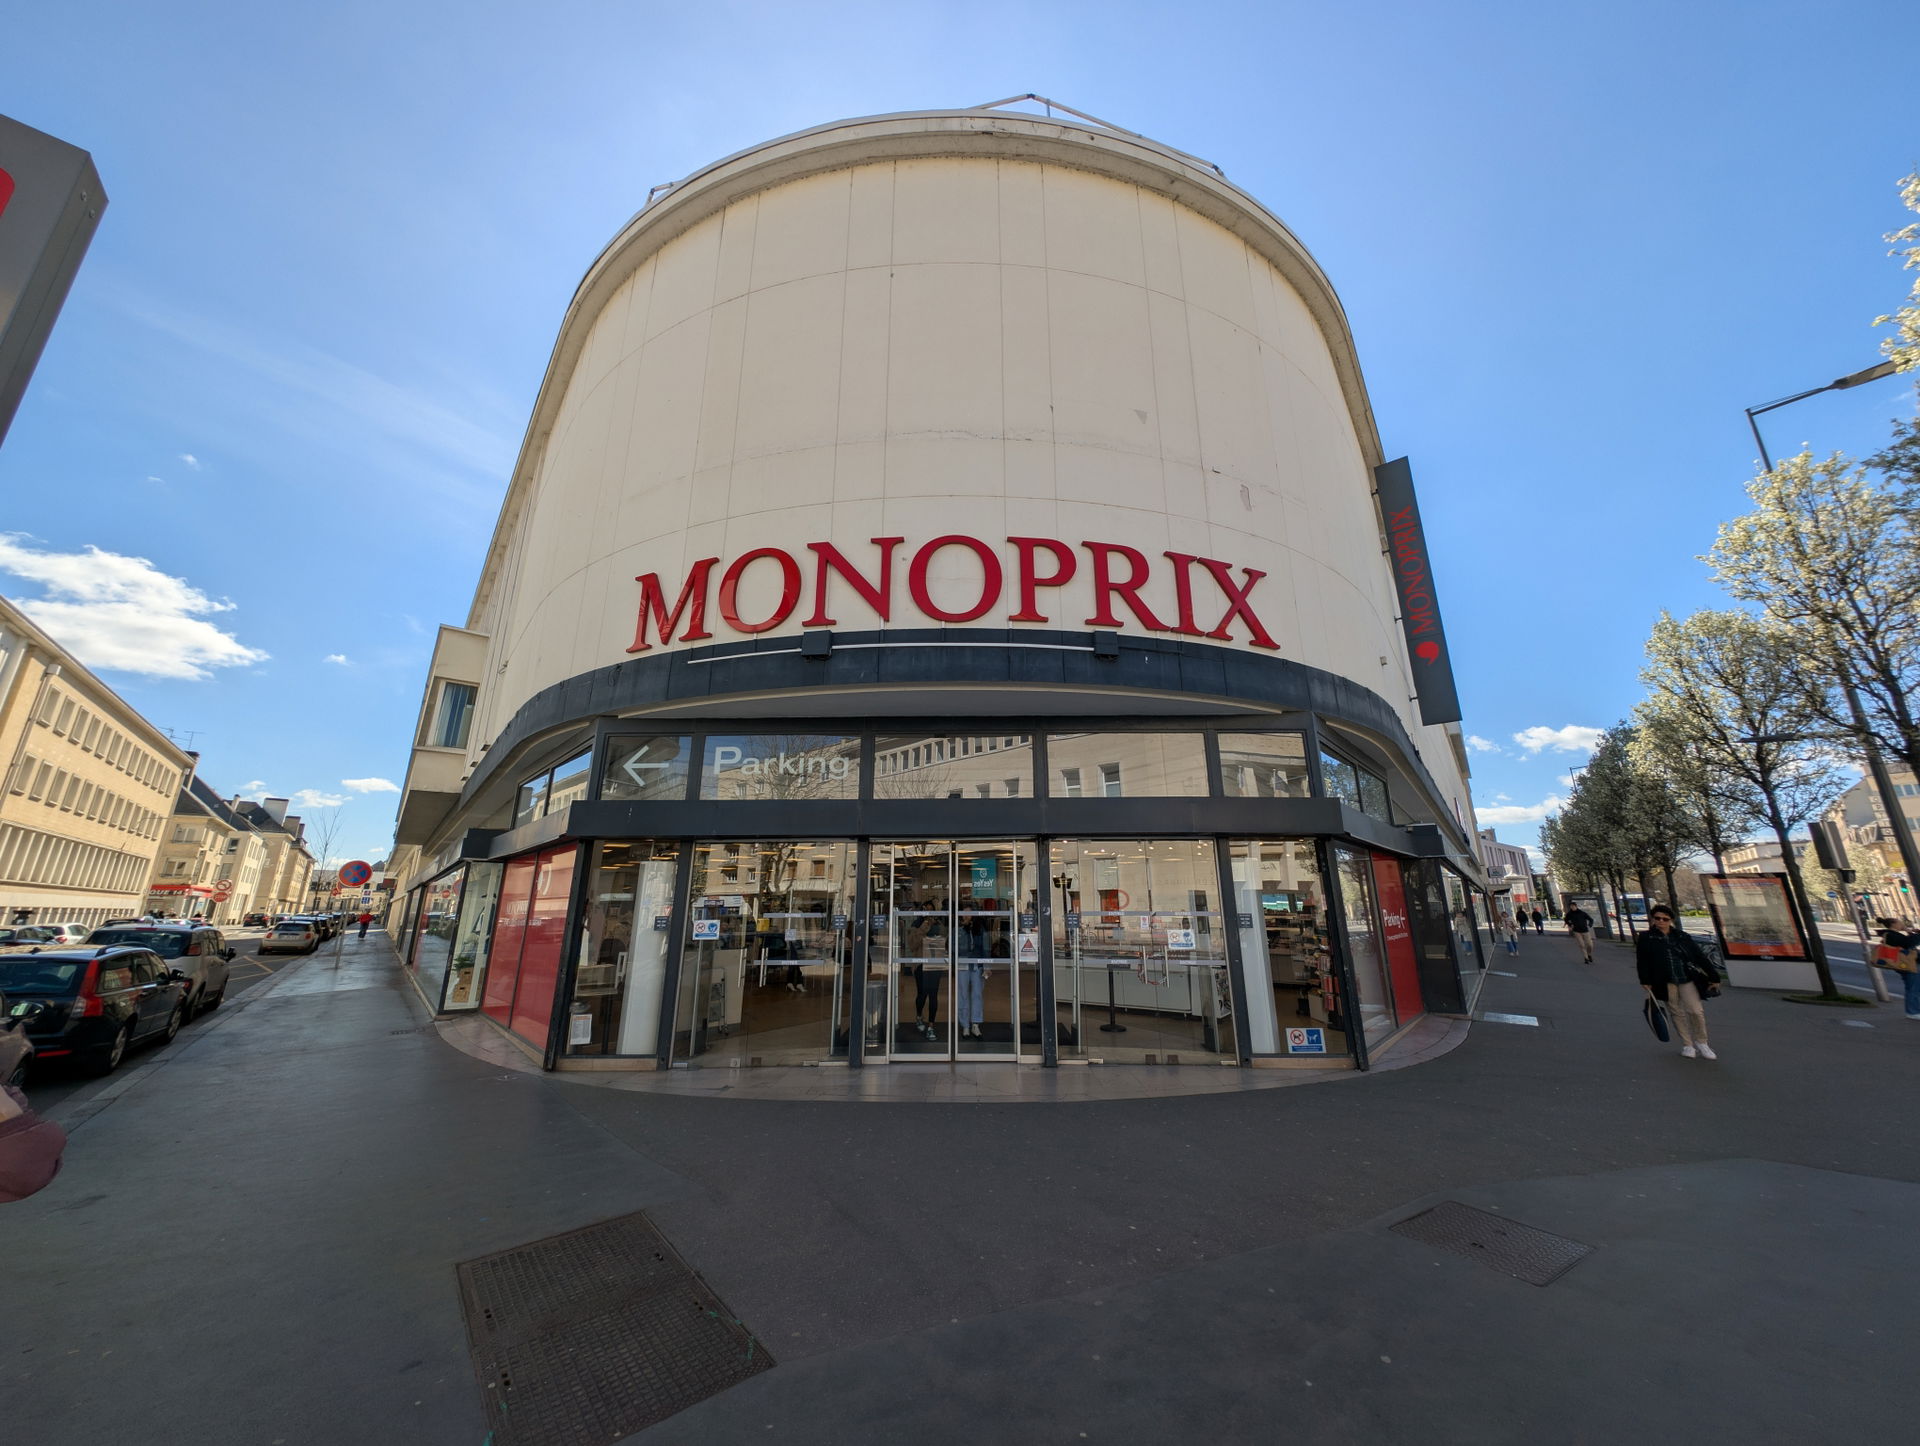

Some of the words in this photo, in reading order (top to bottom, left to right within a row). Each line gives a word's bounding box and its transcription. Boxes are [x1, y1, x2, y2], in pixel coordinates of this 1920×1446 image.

[626, 535, 1281, 653] MONOPRIX
[1390, 506, 1435, 635] MONOPRIX
[713, 746, 850, 780] Parking
